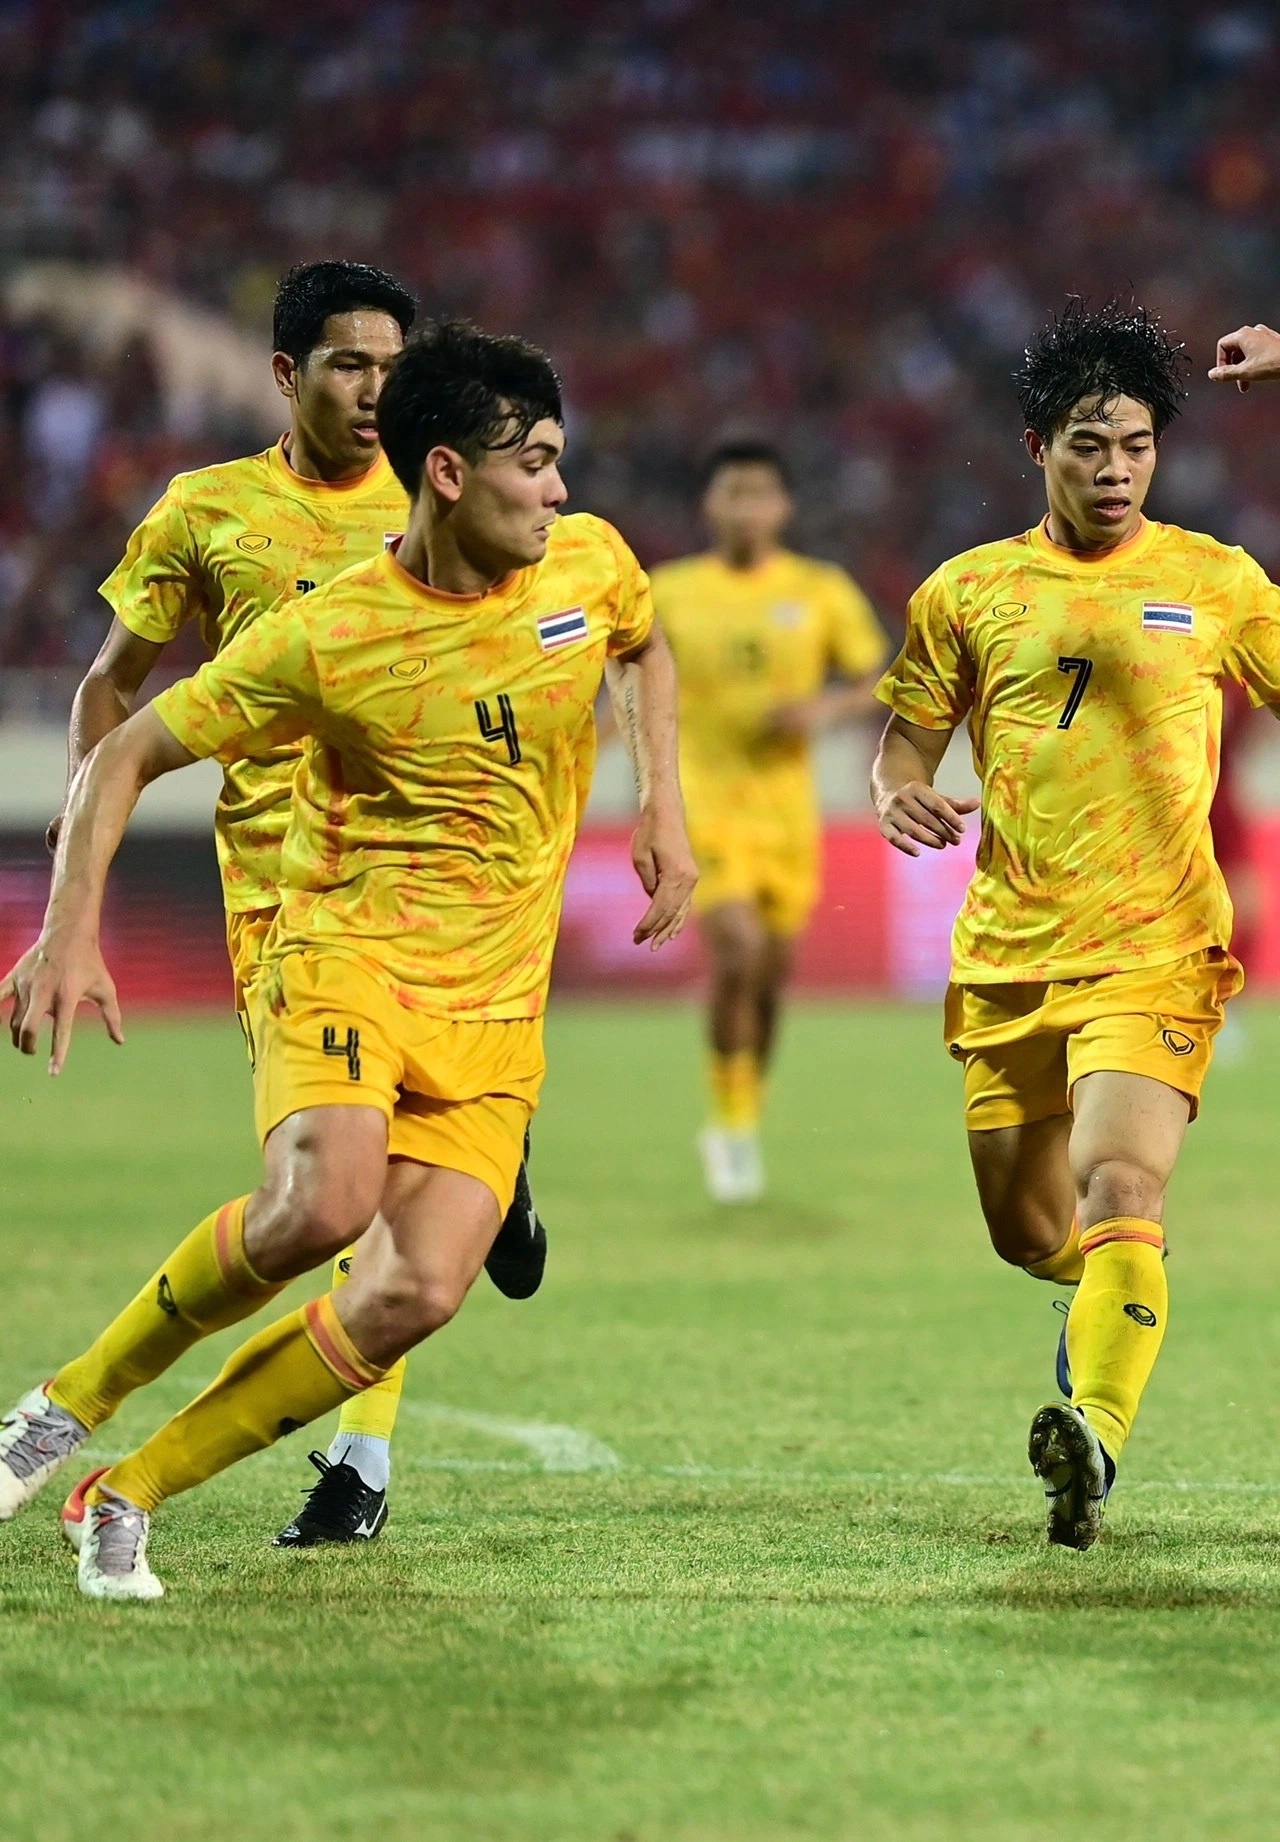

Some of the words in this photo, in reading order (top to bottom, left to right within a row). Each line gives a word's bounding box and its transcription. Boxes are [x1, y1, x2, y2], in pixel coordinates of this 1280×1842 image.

[474, 693, 522, 766] 4
[1057, 656, 1093, 730] 7
[323, 1027, 361, 1081] 4
